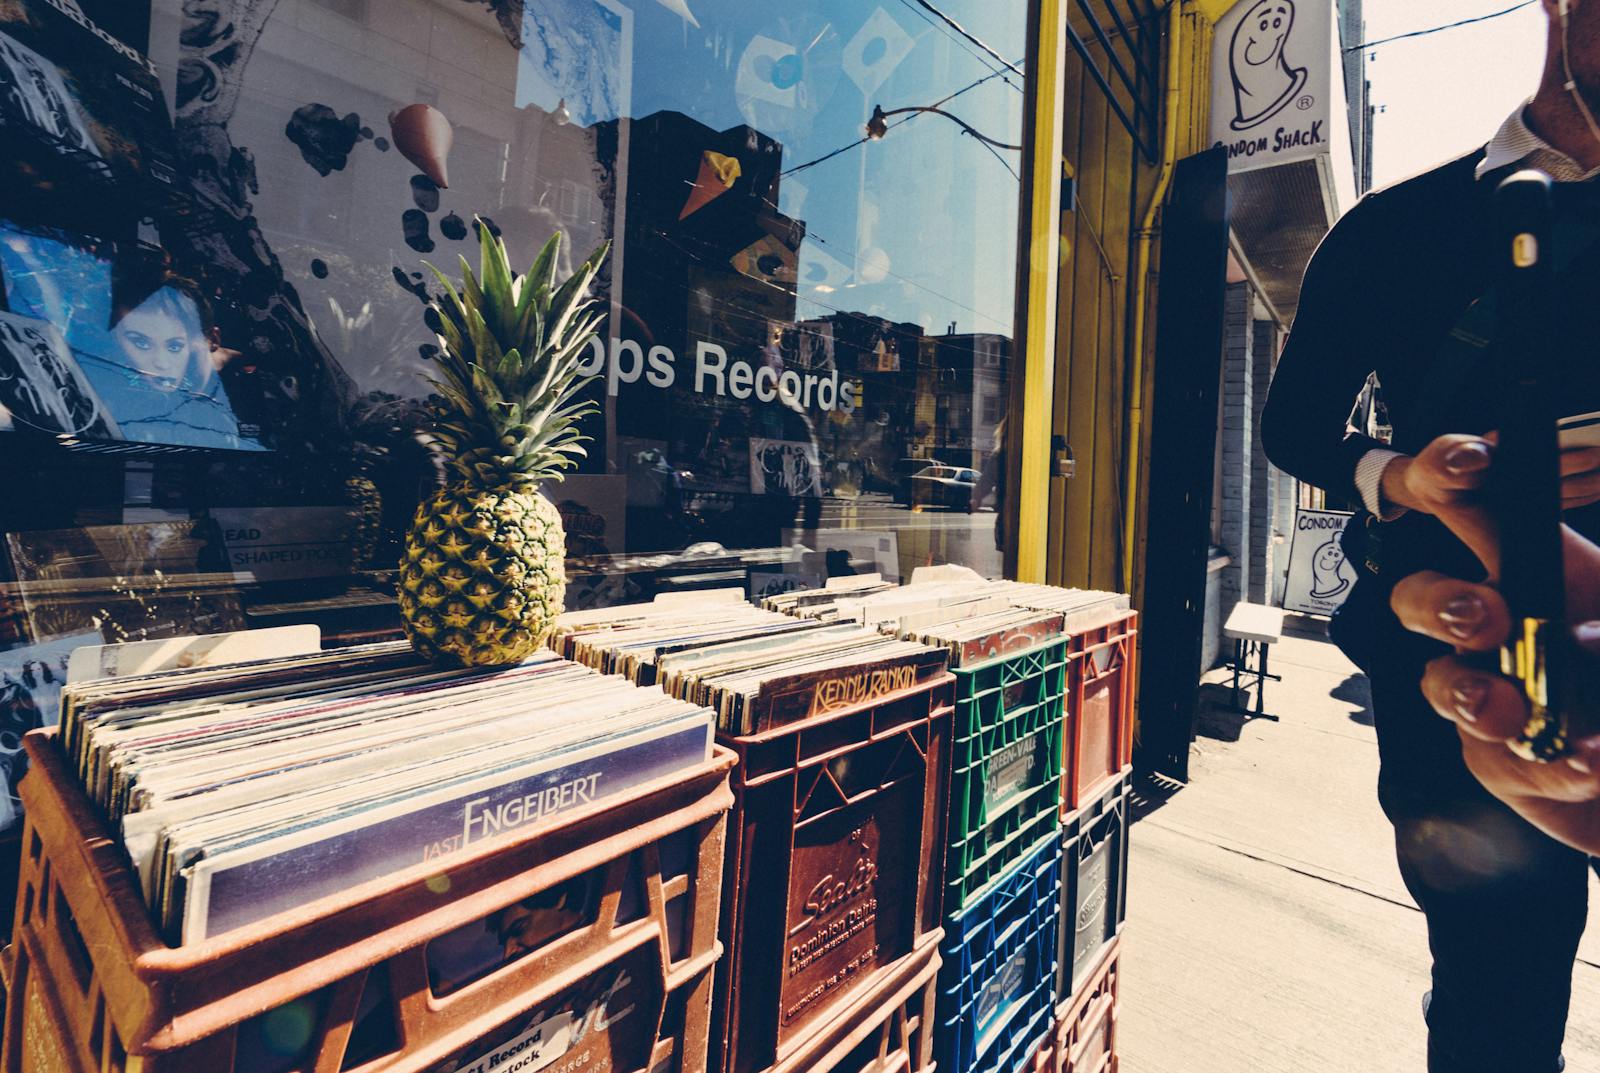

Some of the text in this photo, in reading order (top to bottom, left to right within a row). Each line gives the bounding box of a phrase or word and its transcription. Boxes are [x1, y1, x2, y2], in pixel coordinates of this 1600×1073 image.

[694, 340, 856, 413] Records
[1298, 516, 1342, 530] CONDOM
[233, 549, 301, 565] SHAPED
[811, 664, 917, 718] KENNY RANKIN
[462, 772, 602, 847] ENGELBERT
[791, 918, 846, 964] Dominion
[488, 1028, 543, 1070] Record
